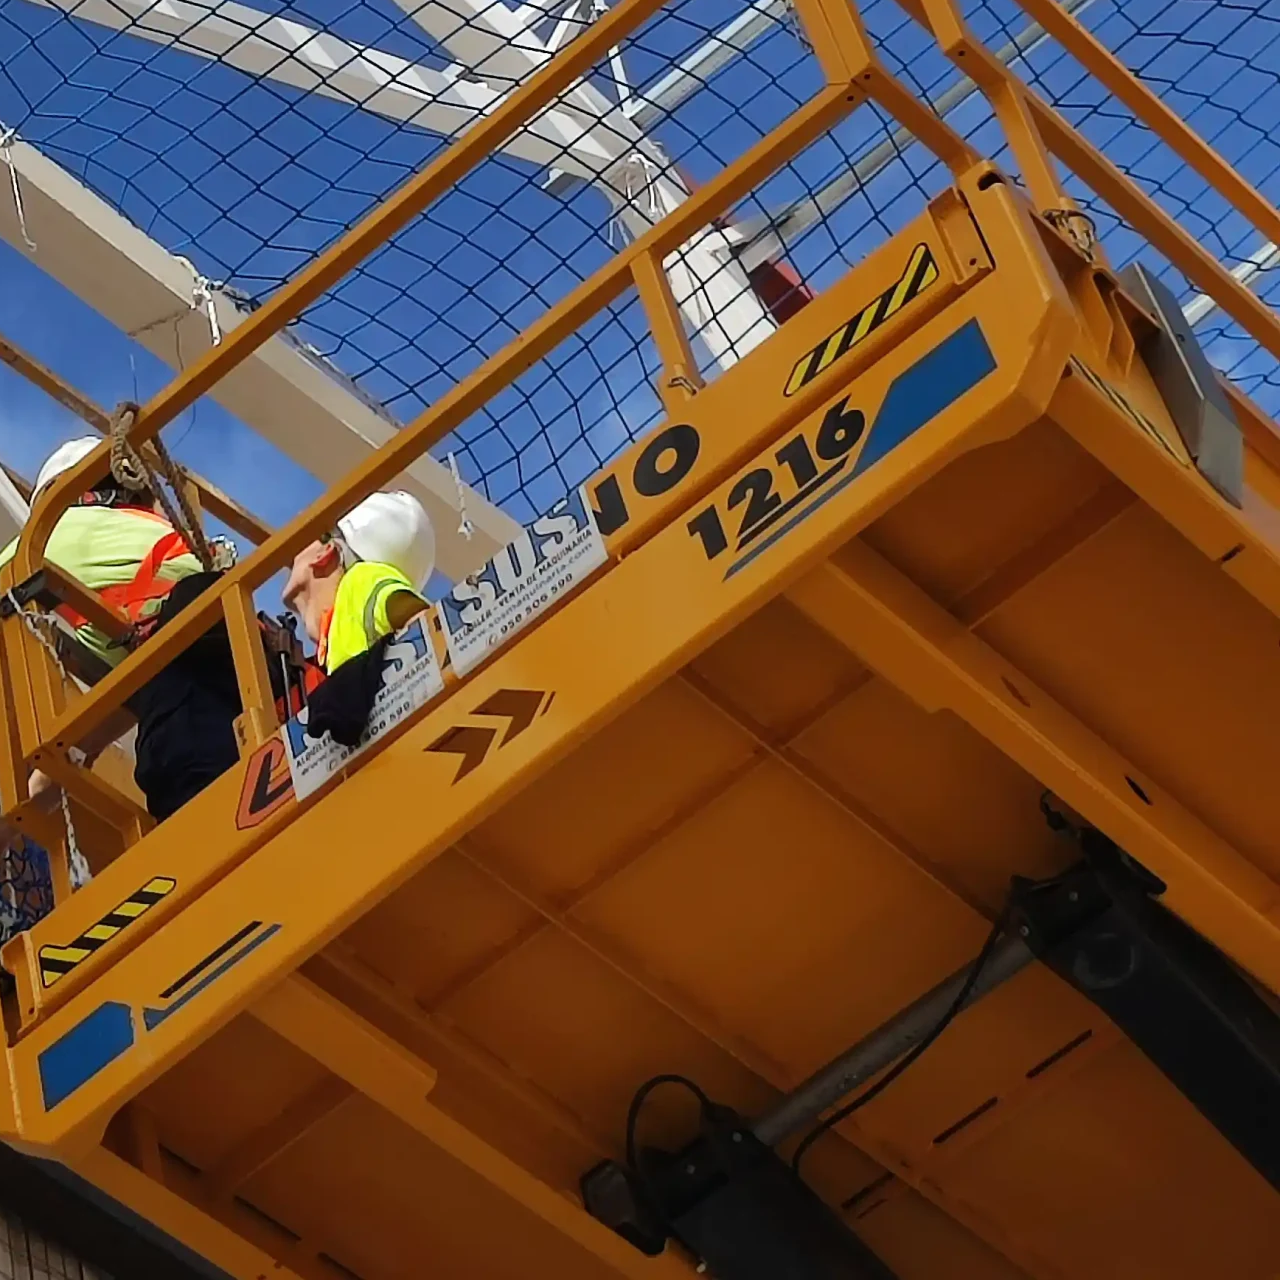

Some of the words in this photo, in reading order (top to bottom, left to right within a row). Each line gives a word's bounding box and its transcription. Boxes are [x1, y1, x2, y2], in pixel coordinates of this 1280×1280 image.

[686, 393, 866, 560] 1216
[498, 583, 526, 608] VENTA
[526, 572, 538, 586] DE
[538, 528, 593, 576] MAQUINARIA
